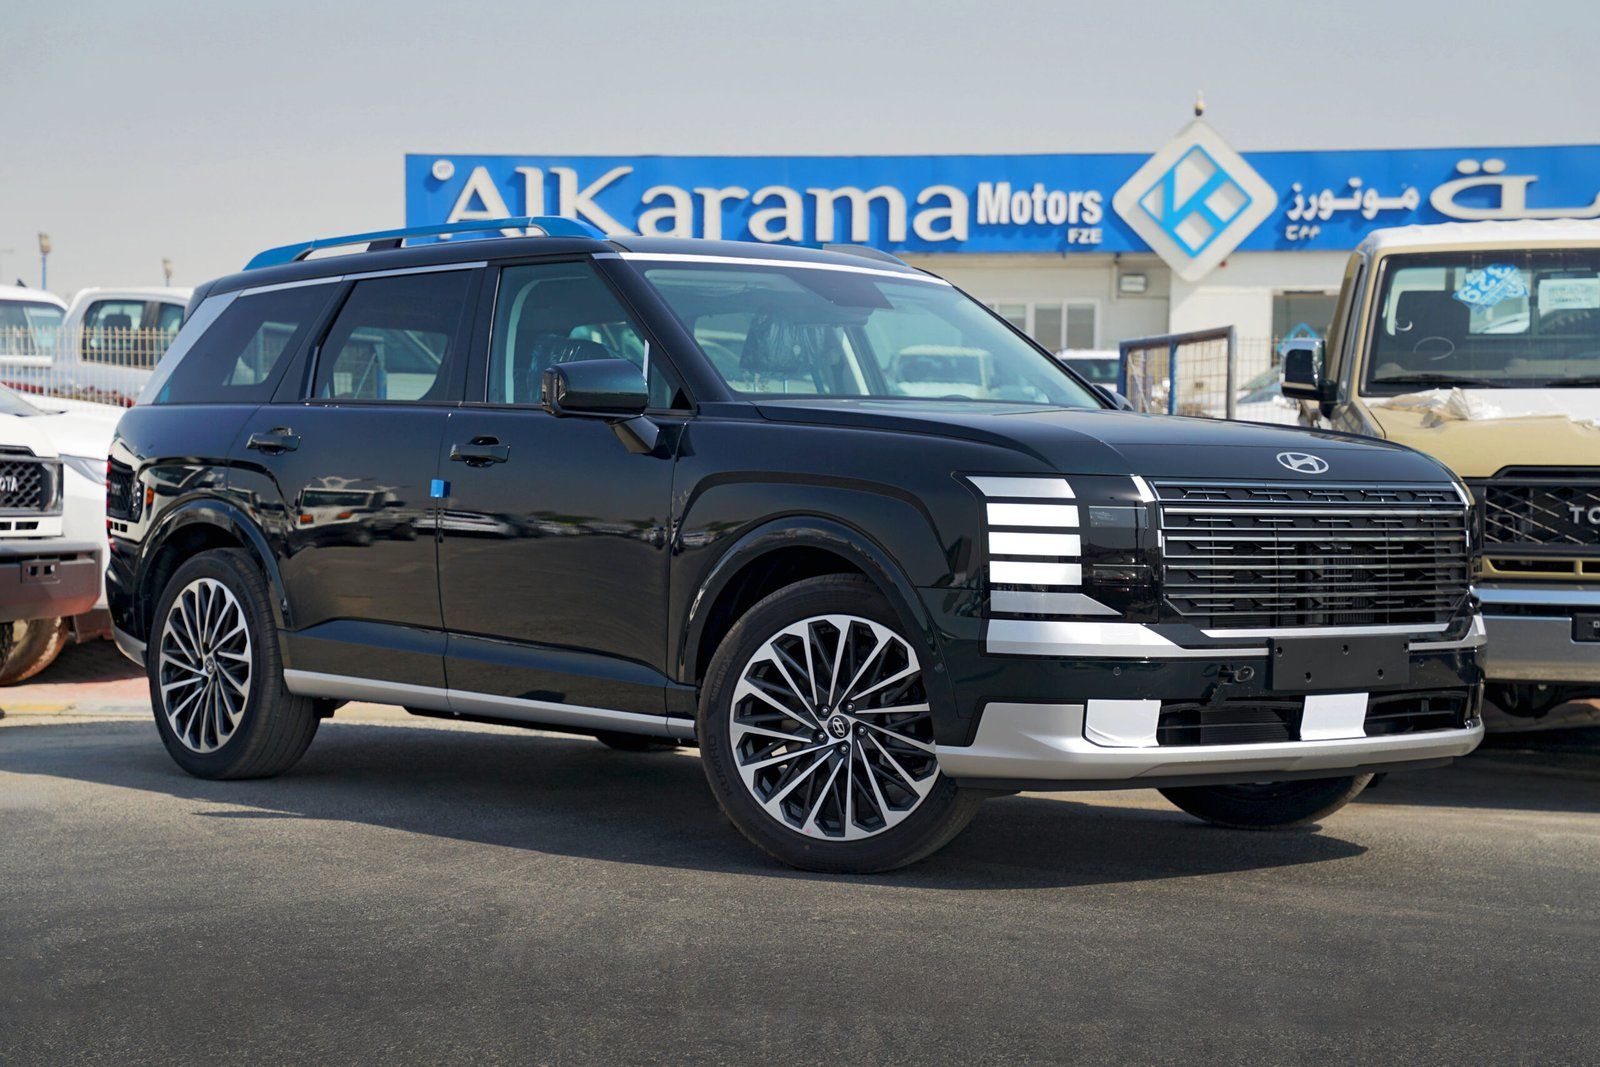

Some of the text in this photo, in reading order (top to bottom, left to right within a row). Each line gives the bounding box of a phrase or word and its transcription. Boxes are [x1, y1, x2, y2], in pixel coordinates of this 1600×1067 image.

[437, 165, 1103, 243] AlKarama Motors
[1286, 177, 1420, 221] موتورز
[1067, 227, 1103, 245] FZE
